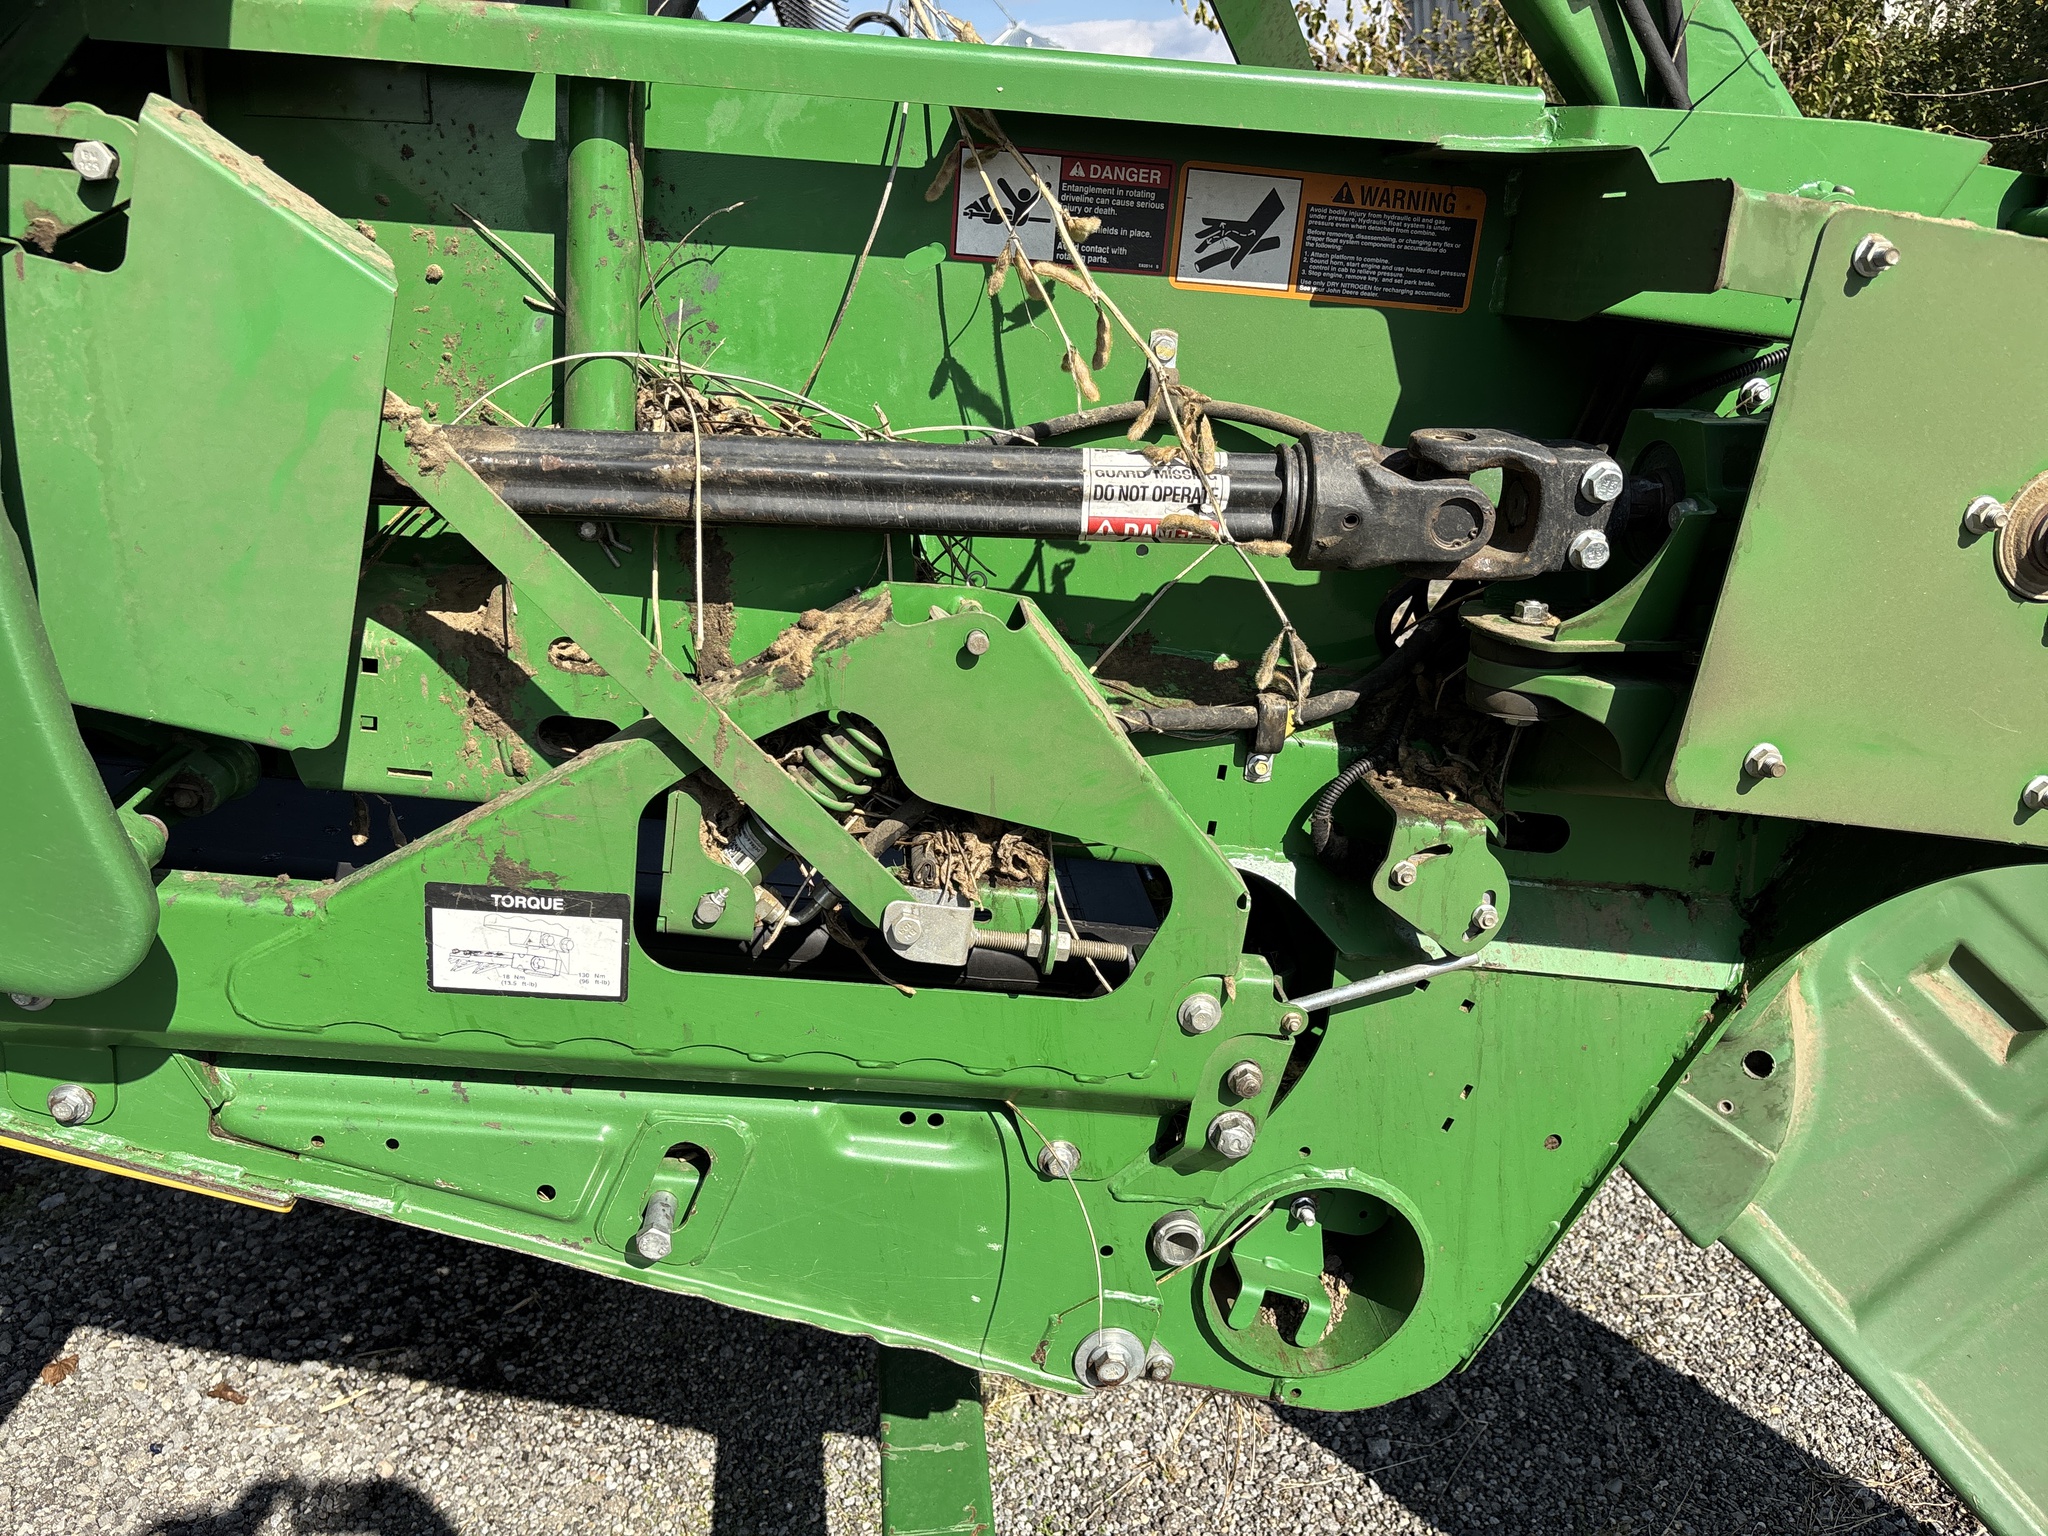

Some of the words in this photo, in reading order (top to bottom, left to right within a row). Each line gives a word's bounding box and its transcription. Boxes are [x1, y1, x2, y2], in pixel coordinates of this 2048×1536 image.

[1090, 165, 1161, 183] DANGER
[1062, 183, 1114, 195] Entanglement
[1116, 188, 1123, 196] in
[1126, 190, 1155, 200] rotating
[1061, 194, 1094, 203] driveline
[1112, 198, 1134, 207] cause
[1136, 201, 1165, 210] serious
[1360, 185, 1456, 214] WARNING
[1094, 207, 1117, 215] death.
[1129, 229, 1152, 238] place.
[1316, 242, 1343, 250] following:
[1356, 234, 1397, 243] disassembling,
[1406, 239, 1431, 247] changing
[1081, 245, 1109, 254] contact
[1111, 247, 1127, 255] with
[1087, 256, 1109, 264] parts.
[1383, 286, 1413, 296] recharging
[1095, 469, 1146, 478] GUARD
[1094, 485, 1114, 500] DO
[1118, 486, 1150, 501] NOT
[491, 894, 564, 910] TORQUE
